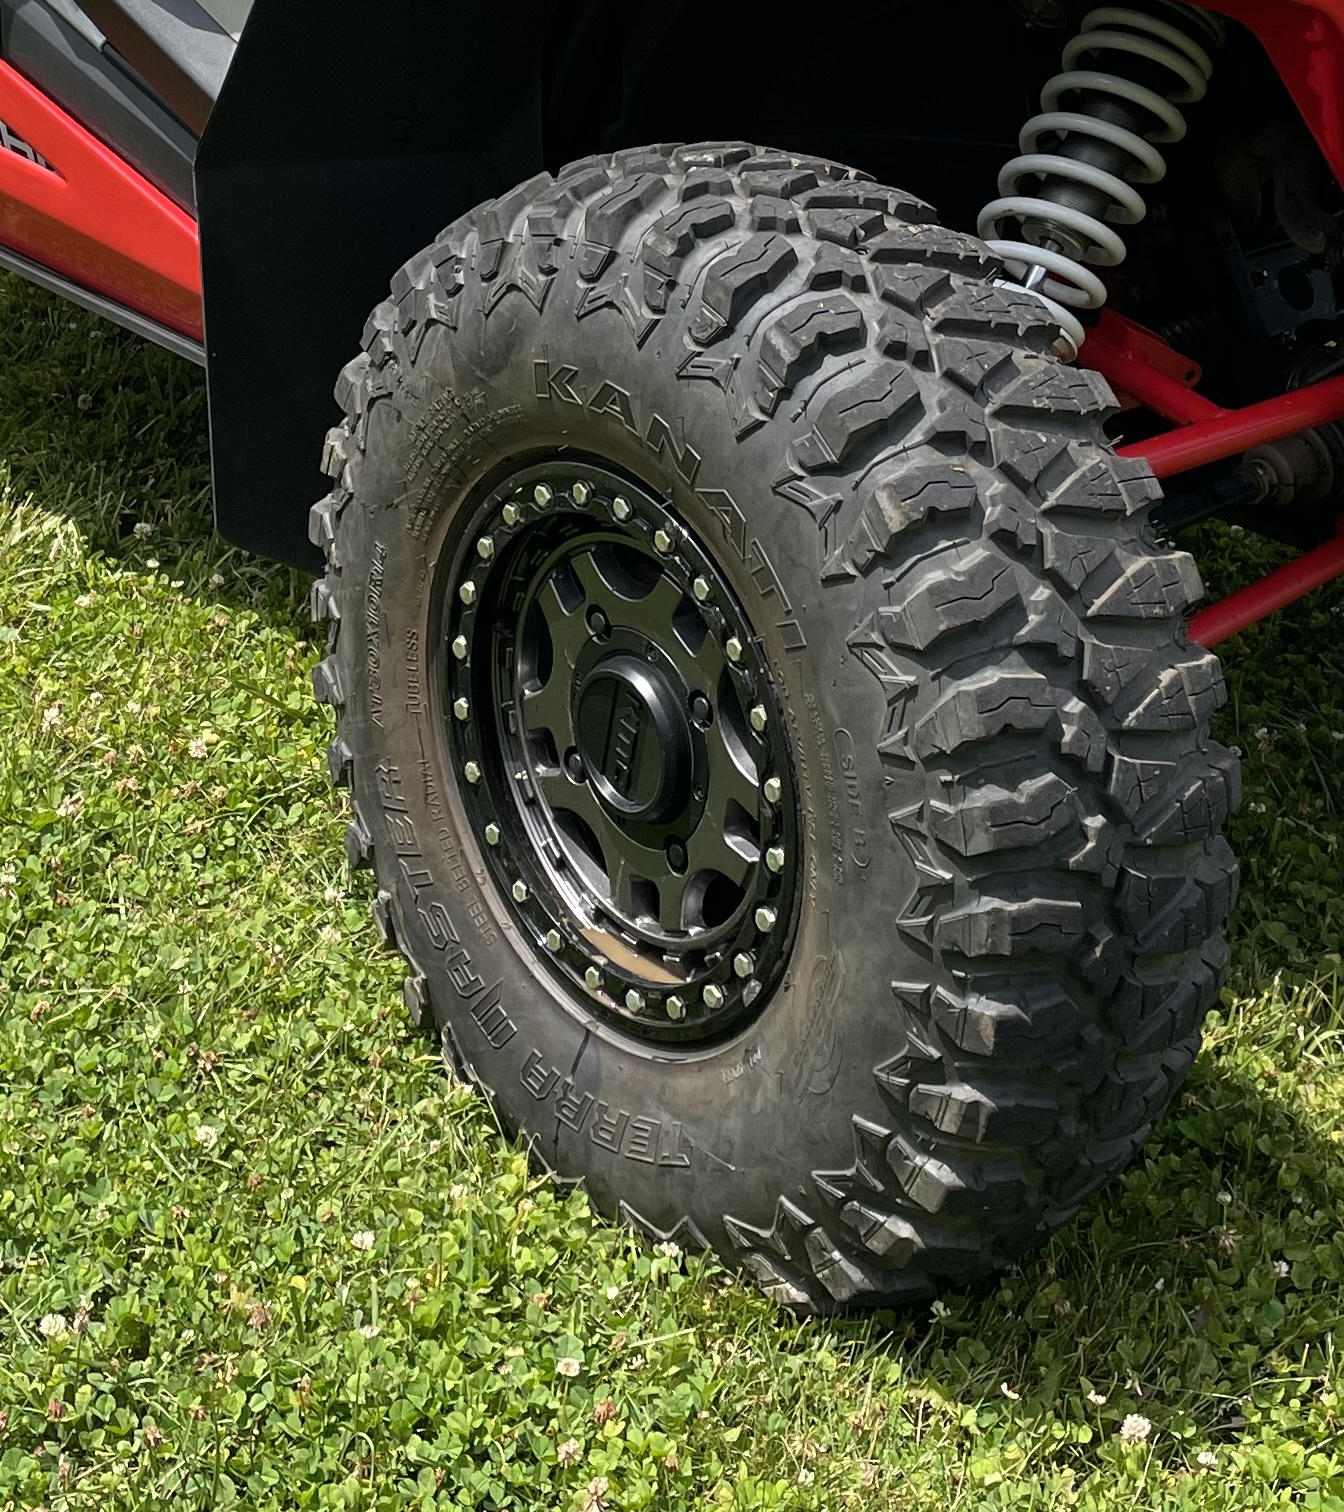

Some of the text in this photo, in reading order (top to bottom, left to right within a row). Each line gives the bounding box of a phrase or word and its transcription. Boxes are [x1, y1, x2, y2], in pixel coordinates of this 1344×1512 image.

[533, 359, 807, 650] KANATI
[406, 627, 422, 716] TUBELESS
[417, 758, 498, 947] STEEL BELTED RADIAL
[840, 753, 863, 817] SIDE
[375, 758, 691, 1169] TERRA MASTER
